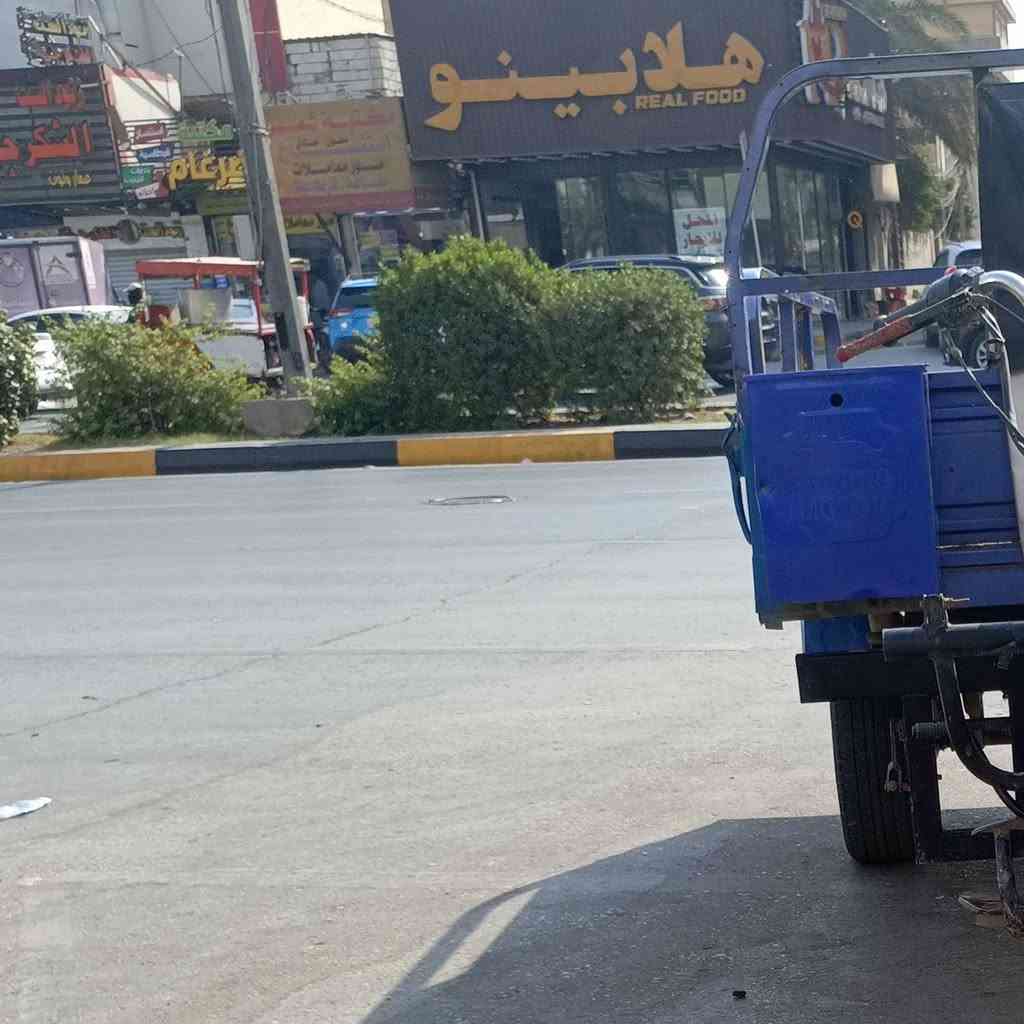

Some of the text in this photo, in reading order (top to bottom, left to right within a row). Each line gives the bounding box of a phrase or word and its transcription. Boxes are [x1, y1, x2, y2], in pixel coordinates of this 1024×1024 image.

[424, 20, 765, 132] هلابينو
[635, 88, 748, 111] REAL FOOD
[0, 117, 93, 176] الشكرج
